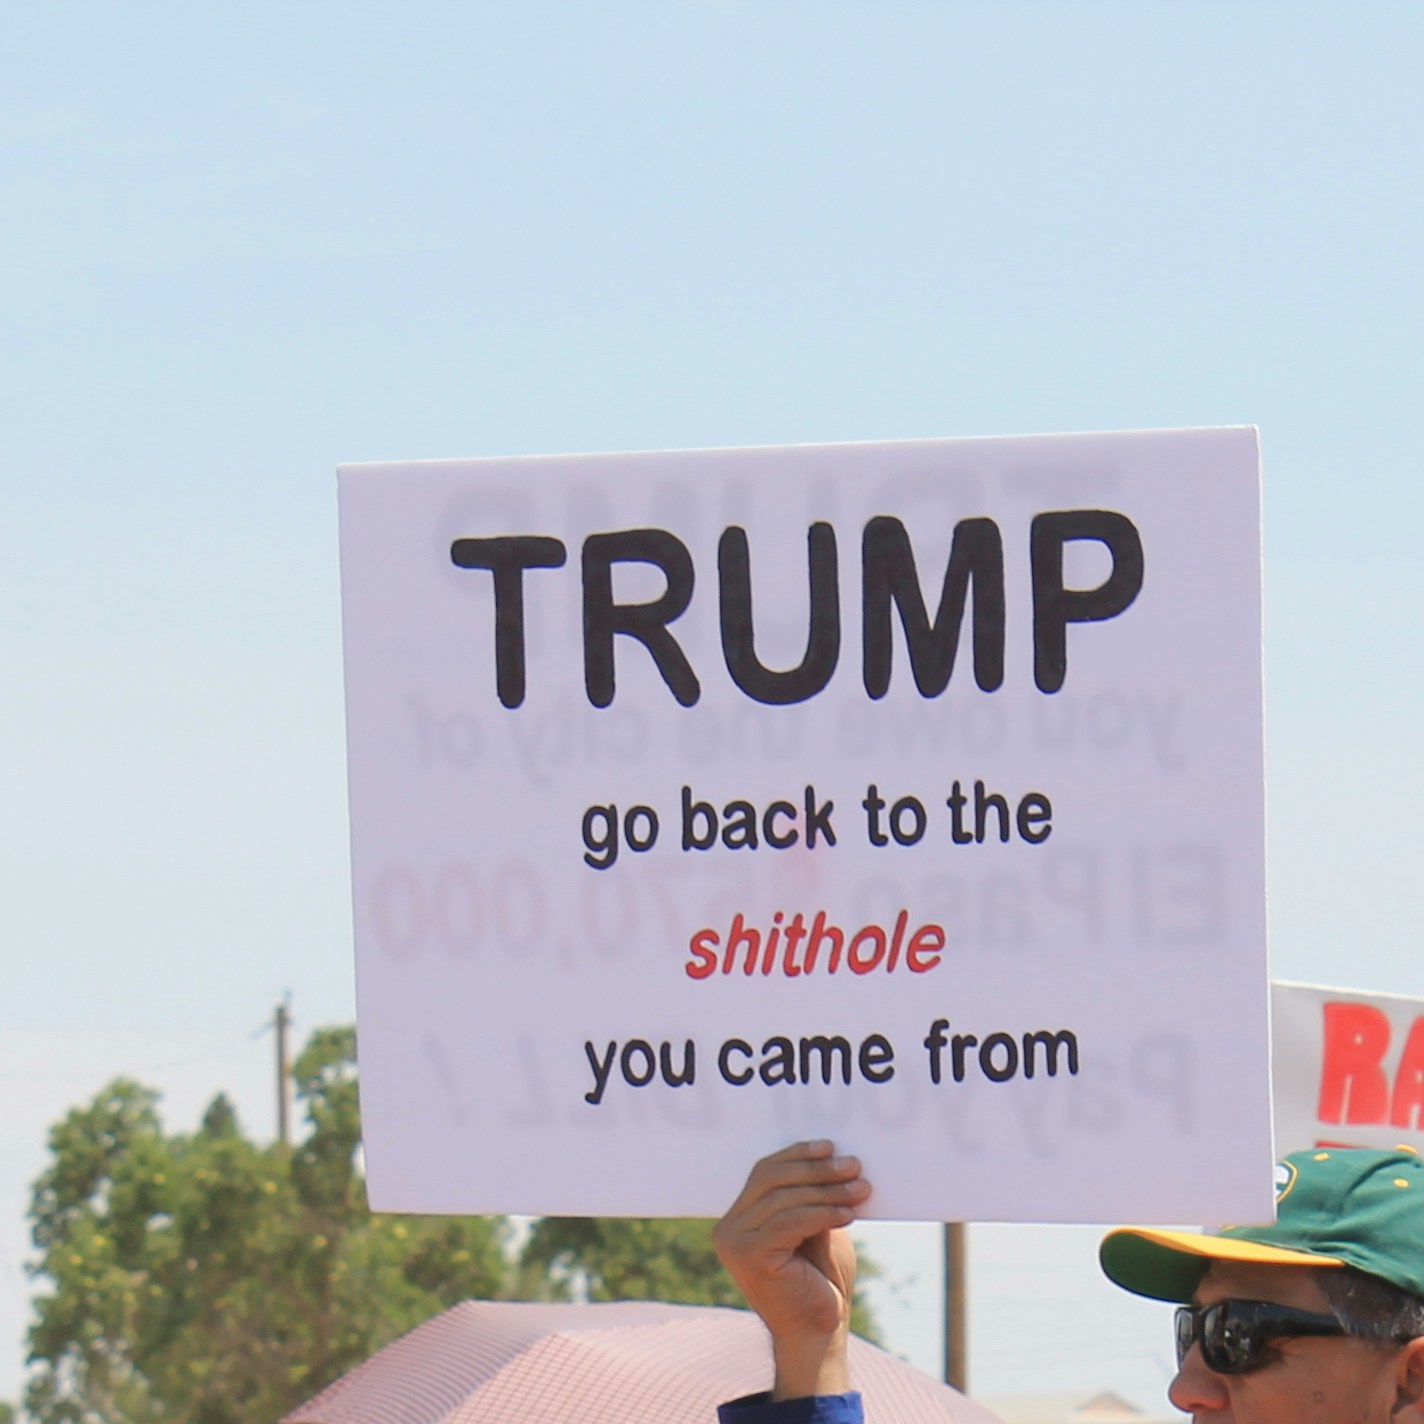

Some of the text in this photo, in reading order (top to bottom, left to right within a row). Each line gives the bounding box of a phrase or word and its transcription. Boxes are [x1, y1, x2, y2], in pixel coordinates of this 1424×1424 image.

[449, 508, 1146, 710] TRUMP
[580, 780, 1054, 870] go back to the
[683, 910, 947, 981] shithole
[583, 1019, 1081, 1104] you came from
